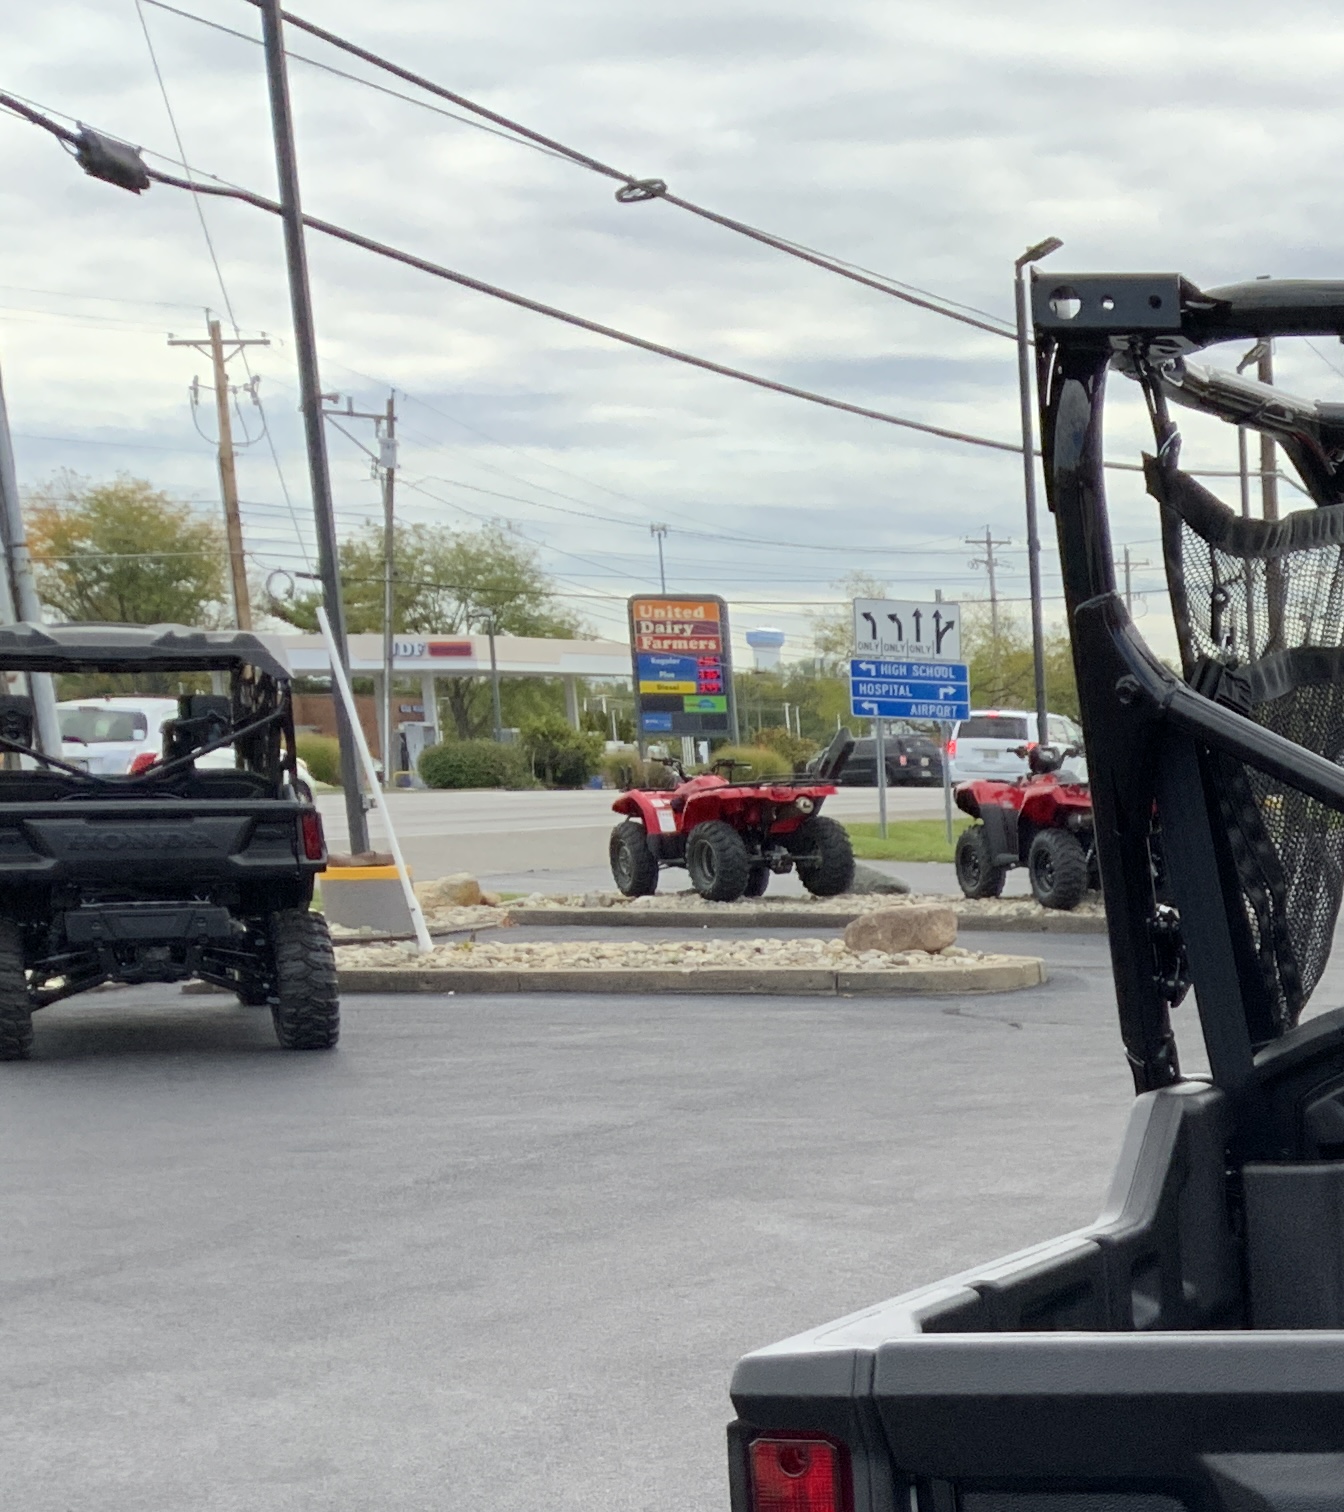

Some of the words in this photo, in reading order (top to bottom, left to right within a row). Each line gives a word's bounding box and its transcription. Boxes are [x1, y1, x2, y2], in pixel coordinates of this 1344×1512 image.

[639, 605, 705, 619] United
[640, 621, 694, 636] Dairy
[641, 636, 717, 650] Farmers
[857, 641, 880, 651] ONLY
[883, 642, 906, 652] ONLY
[909, 643, 932, 654] ONLY
[880, 663, 907, 676] HIGH
[912, 664, 956, 679] SCHOOL
[859, 683, 913, 697] HOSPITAL
[910, 703, 958, 718] AIRPORT
